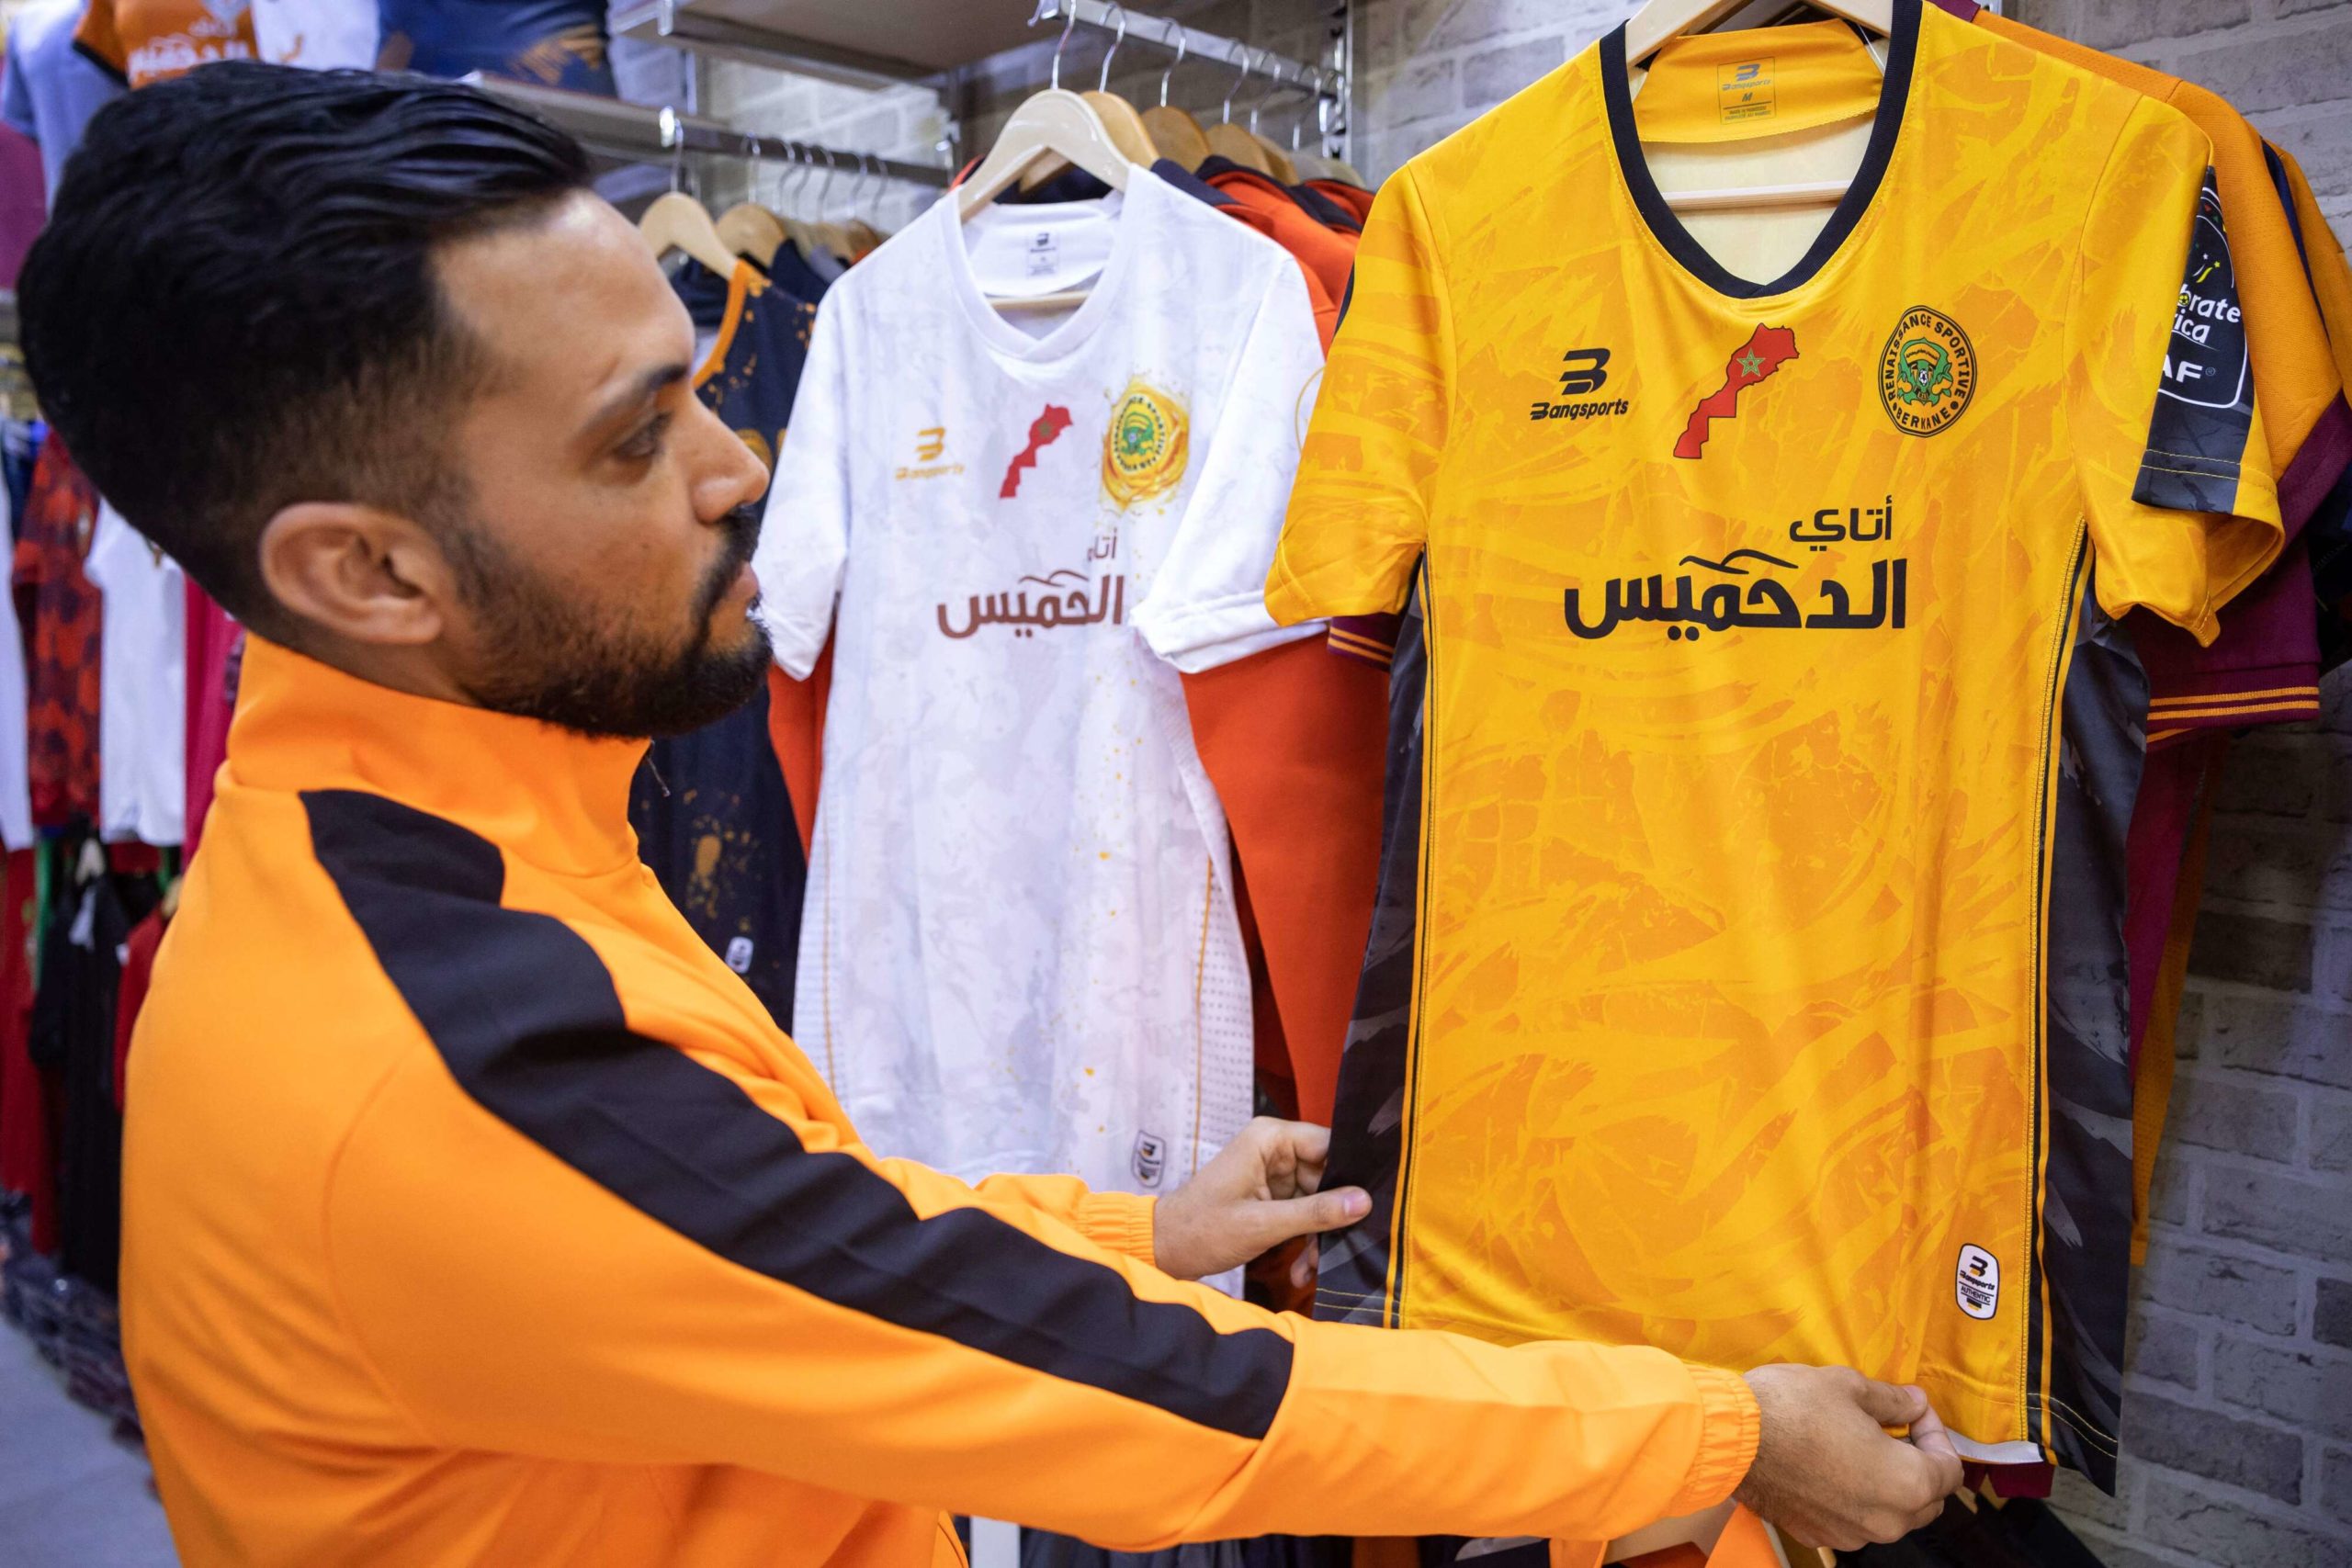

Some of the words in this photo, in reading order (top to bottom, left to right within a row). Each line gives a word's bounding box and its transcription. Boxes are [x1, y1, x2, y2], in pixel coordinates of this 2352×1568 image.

[2177, 283, 2241, 323] brate
[1884, 313, 1931, 401] RENAISSANCE
[1934, 321, 1970, 399] SPORTIVE
[1530, 399, 1629, 421] Bangsports
[1895, 407, 1951, 430] BERKANE
[1789, 495, 1893, 551] أتاي
[1564, 549, 1907, 641] الدحميس
[1961, 1286, 1991, 1303] AUTHENTIC
